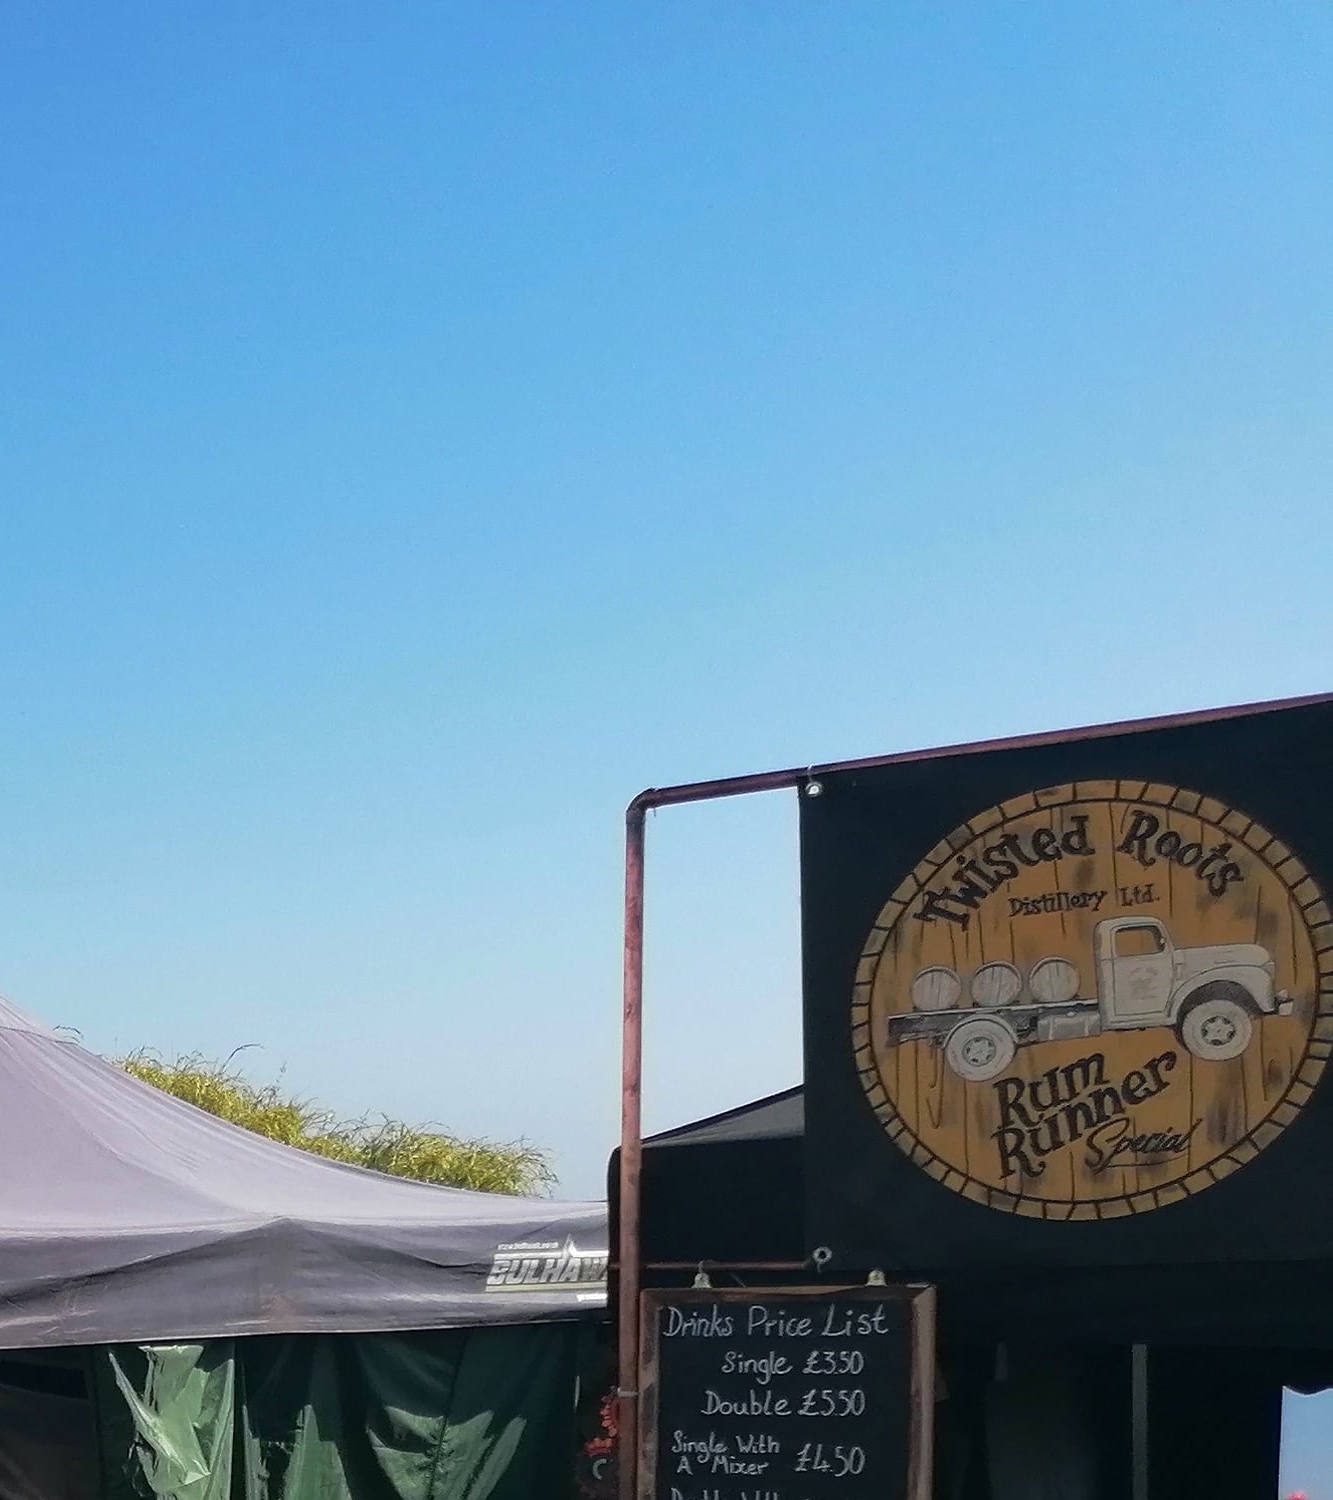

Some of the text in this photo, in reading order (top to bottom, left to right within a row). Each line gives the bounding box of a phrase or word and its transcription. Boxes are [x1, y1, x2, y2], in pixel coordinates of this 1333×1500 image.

[913, 810, 1244, 933] Twisted Roots
[1008, 882, 1160, 917] Distillery Ltd.
[993, 1052, 1108, 1131] Rum
[992, 1051, 1177, 1180] Runner
[1085, 1117, 1203, 1176] Special
[663, 1304, 890, 1337] Drinks Price List
[722, 1351, 864, 1384] Single £3.50
[701, 1389, 865, 1416] Double £5.50
[671, 1430, 780, 1463] Single With
[795, 1443, 865, 1477] £4.50
[677, 1456, 769, 1476] A Mixer
